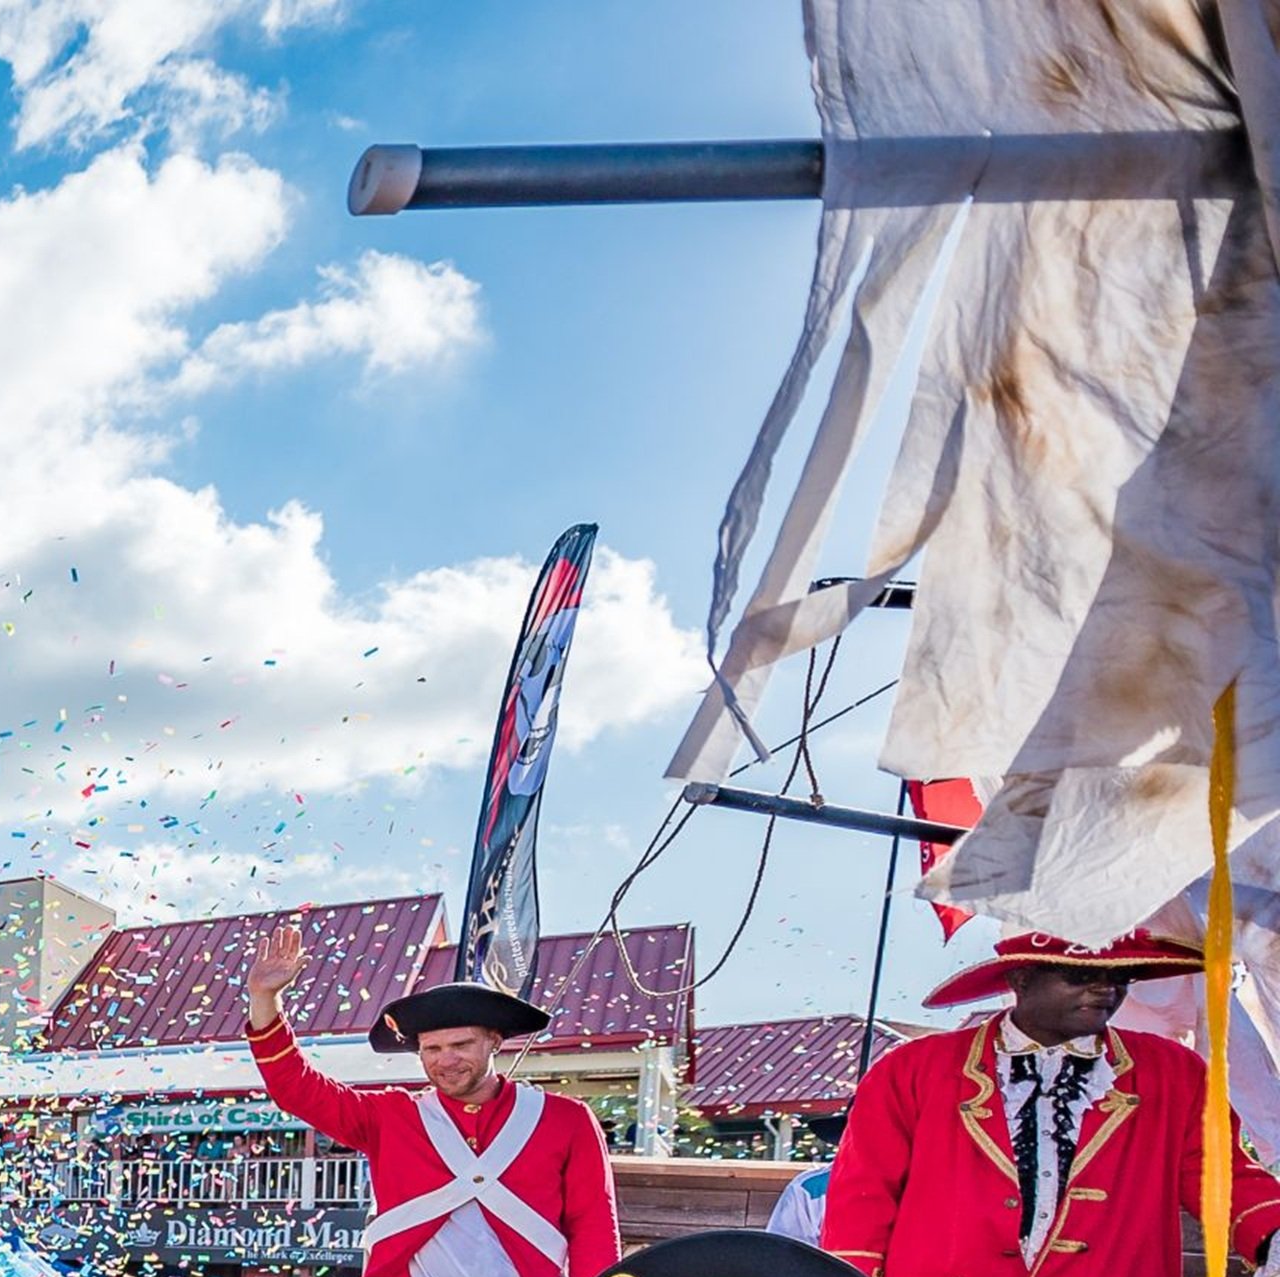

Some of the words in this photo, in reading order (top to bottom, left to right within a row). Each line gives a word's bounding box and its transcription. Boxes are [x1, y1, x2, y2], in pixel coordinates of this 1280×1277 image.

[125, 1111, 194, 1127] Shirts
[198, 1109, 221, 1125] of
[227, 1108, 298, 1126] Cay
[165, 1219, 291, 1248] Diamond
[241, 1249, 258, 1260] The
[261, 1249, 288, 1260] Mark
[304, 1249, 355, 1262] Excellence
